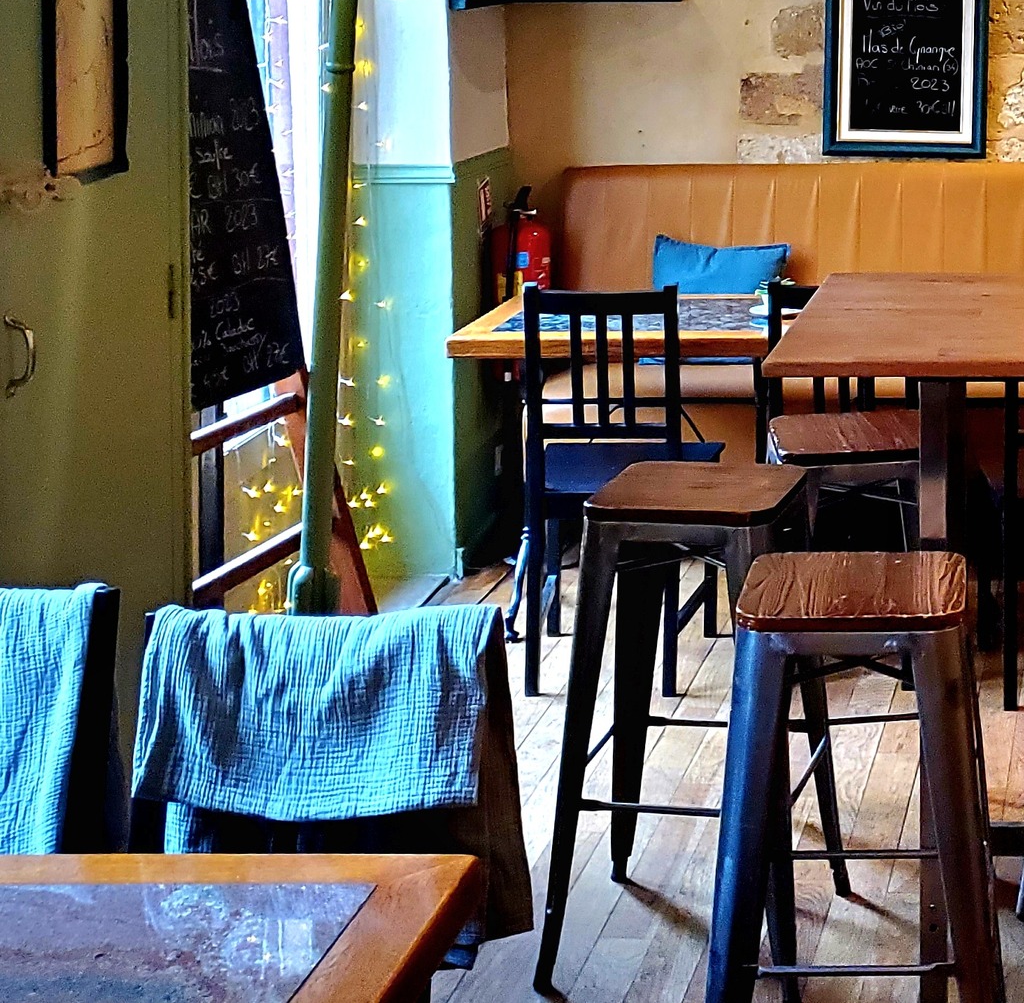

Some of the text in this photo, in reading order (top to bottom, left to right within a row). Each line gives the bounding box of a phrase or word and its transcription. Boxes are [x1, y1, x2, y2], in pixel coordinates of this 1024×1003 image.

[862, 28, 888, 54] Mas
[855, 57, 879, 70] AOC
[910, 76, 951, 93] 2023
